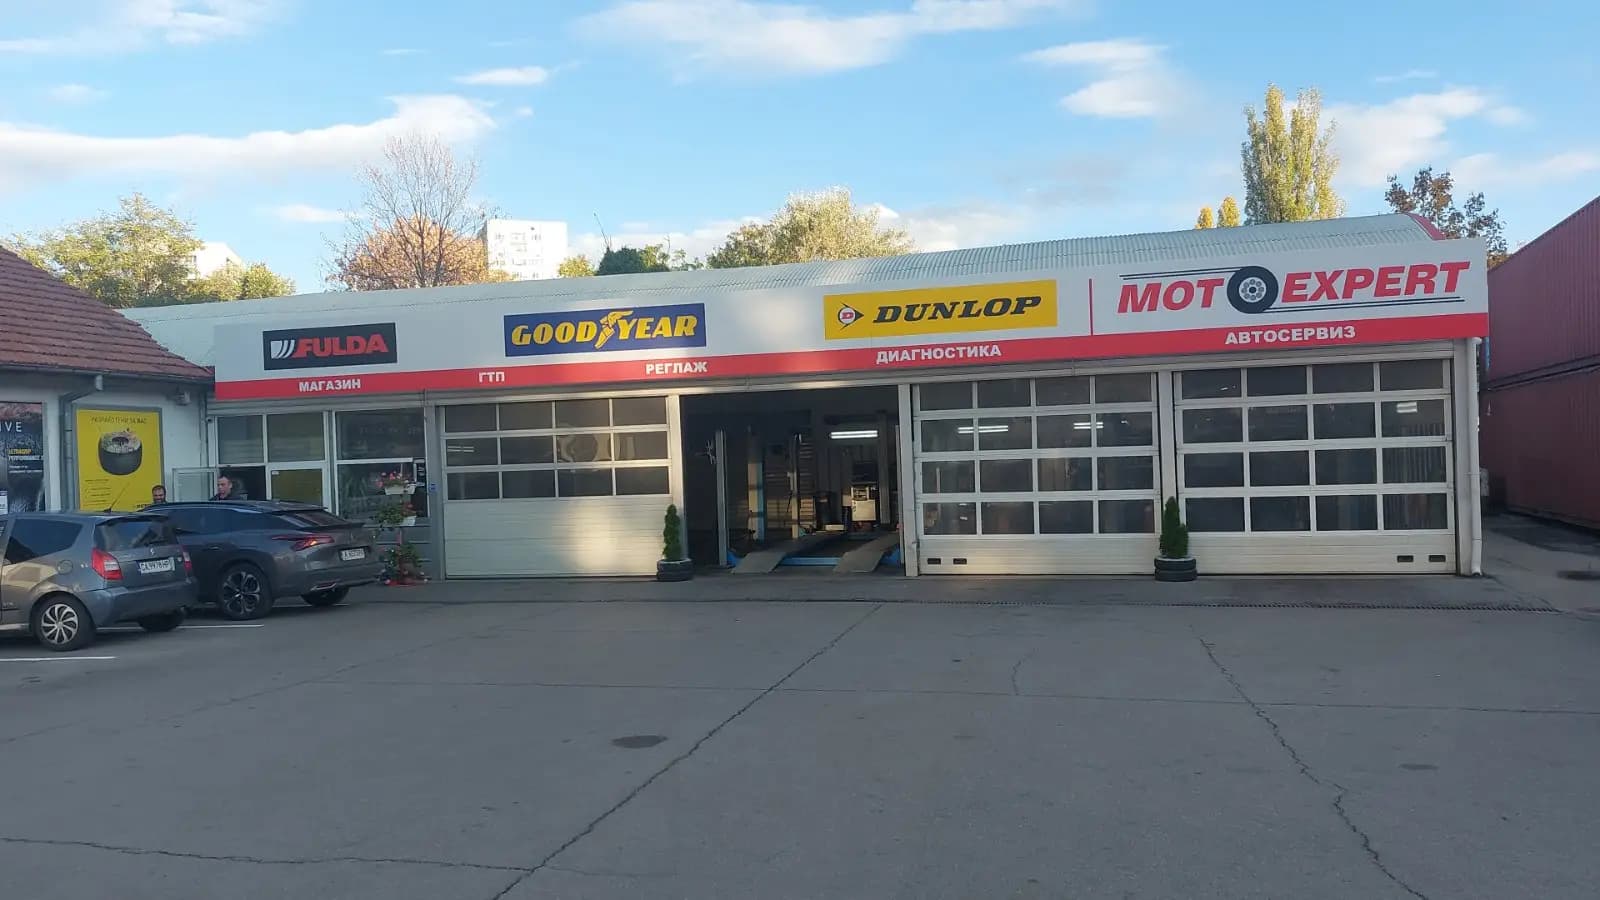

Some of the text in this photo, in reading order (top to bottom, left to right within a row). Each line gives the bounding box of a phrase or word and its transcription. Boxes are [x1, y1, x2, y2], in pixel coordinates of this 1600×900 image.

[1281, 261, 1470, 303] EXPERT
[873, 296, 1041, 323] DUNLOP
[1225, 325, 1355, 345] АВТОСЕРВИЗ
[291, 333, 388, 358] FULDA
[876, 345, 1001, 364] ДИАГНОСТИКА
[479, 371, 505, 383] ГТП
[646, 361, 707, 374] РЕГЛАЖ
[299, 379, 361, 392] МАГАЗИН
